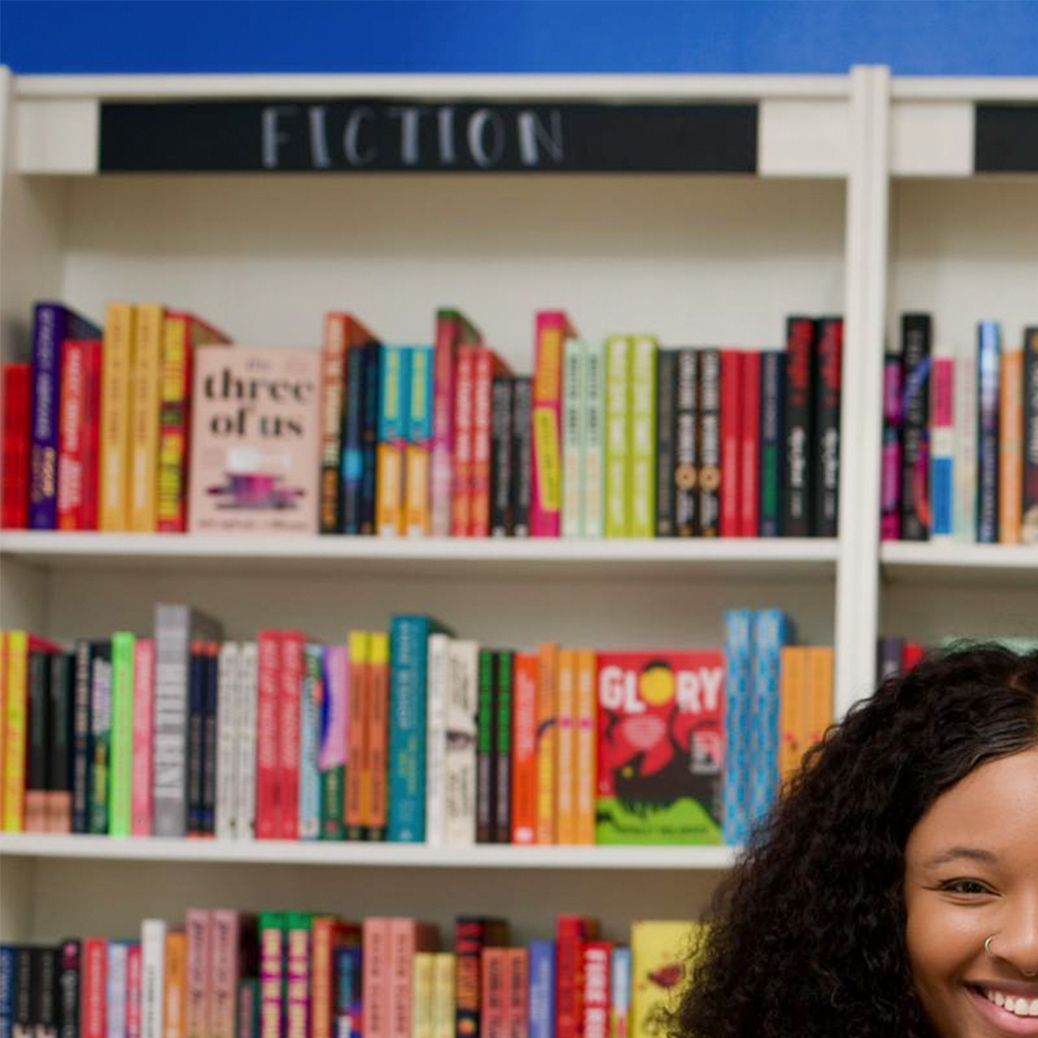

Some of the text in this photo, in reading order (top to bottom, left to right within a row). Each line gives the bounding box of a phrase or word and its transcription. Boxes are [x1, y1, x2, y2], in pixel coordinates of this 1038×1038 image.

[261, 105, 564, 168] FICTION
[204, 366, 316, 402] three
[211, 406, 302, 436] of us
[599, 665, 724, 714] GLORY
